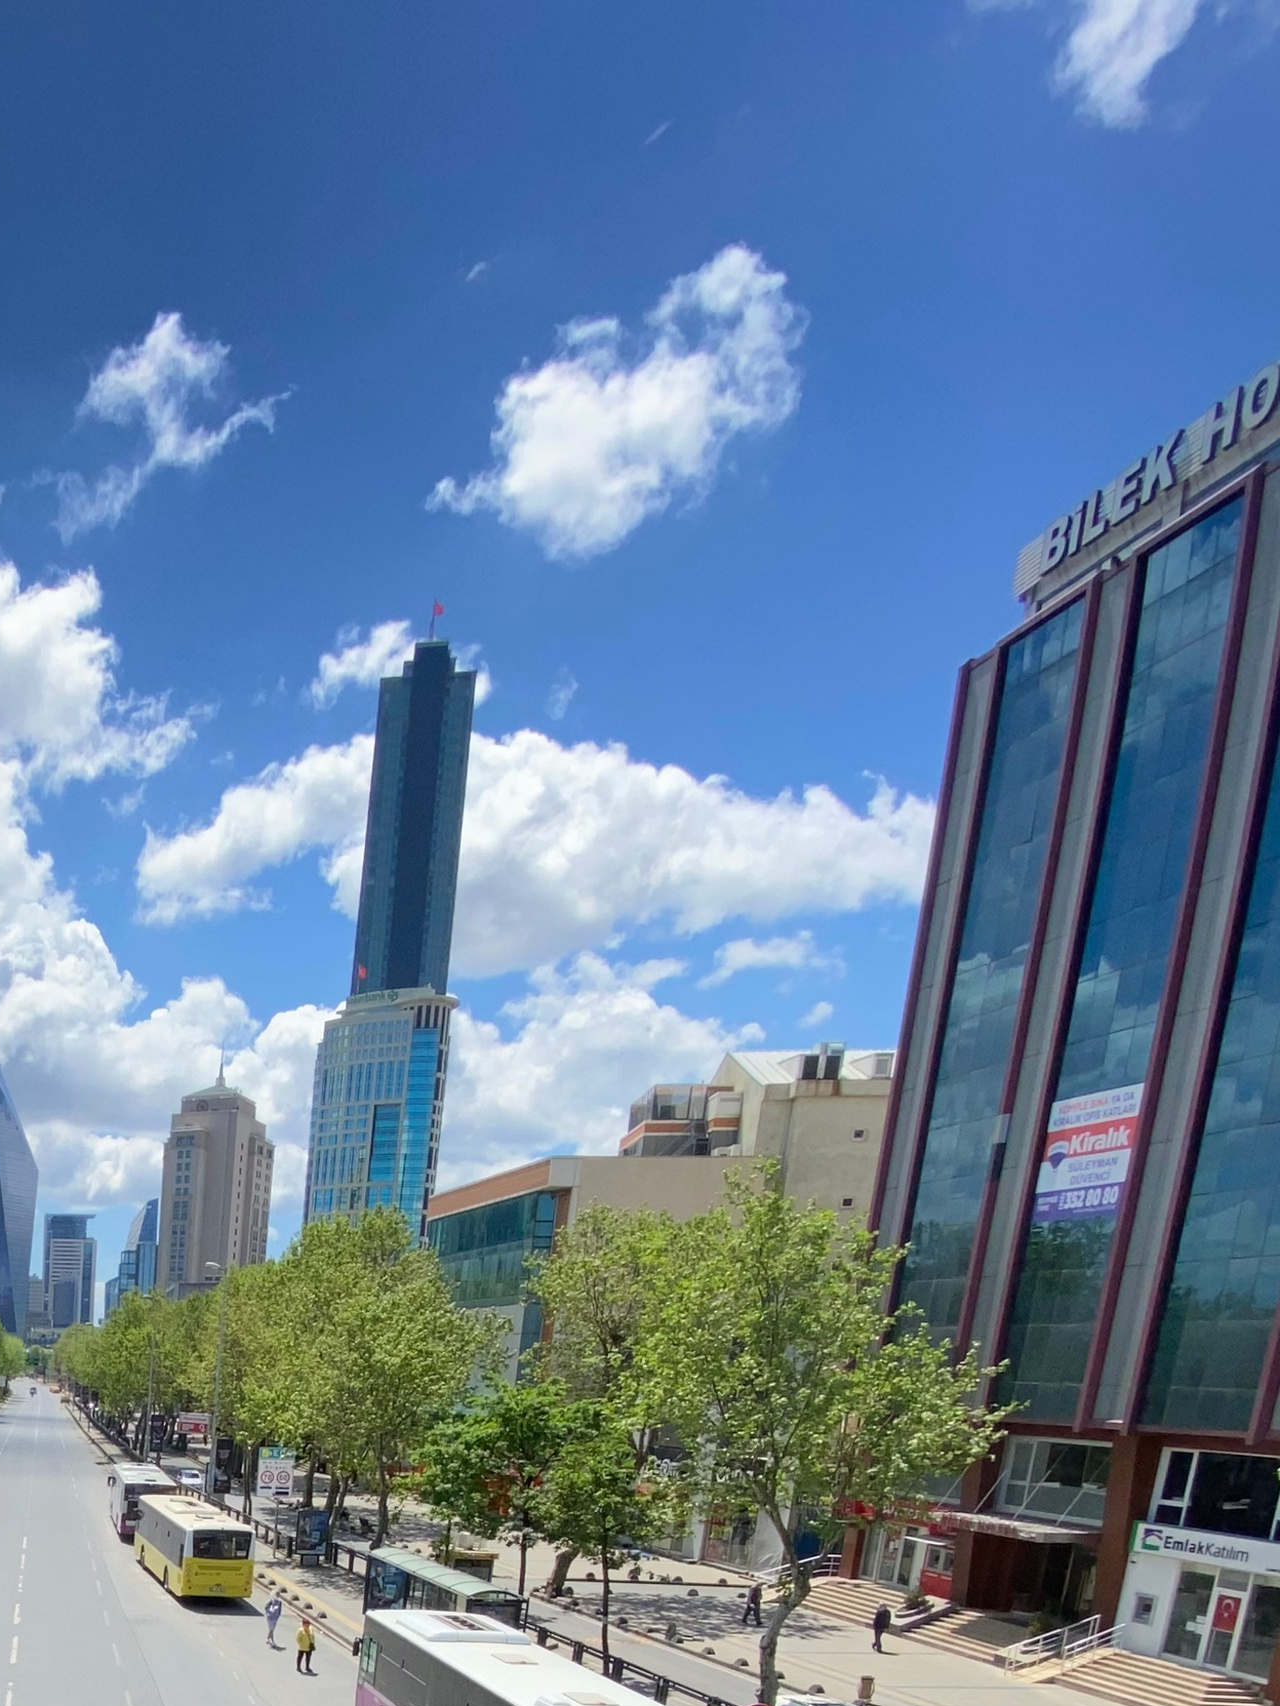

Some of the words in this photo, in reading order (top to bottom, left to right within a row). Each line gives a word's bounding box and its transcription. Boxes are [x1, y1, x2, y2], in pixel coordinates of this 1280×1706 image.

[1201, 362, 1280, 465] HO
[1068, 1126, 1131, 1155] Kiralık
[1085, 1187, 1102, 1206] 80
[1102, 1186, 1119, 1205] 80
